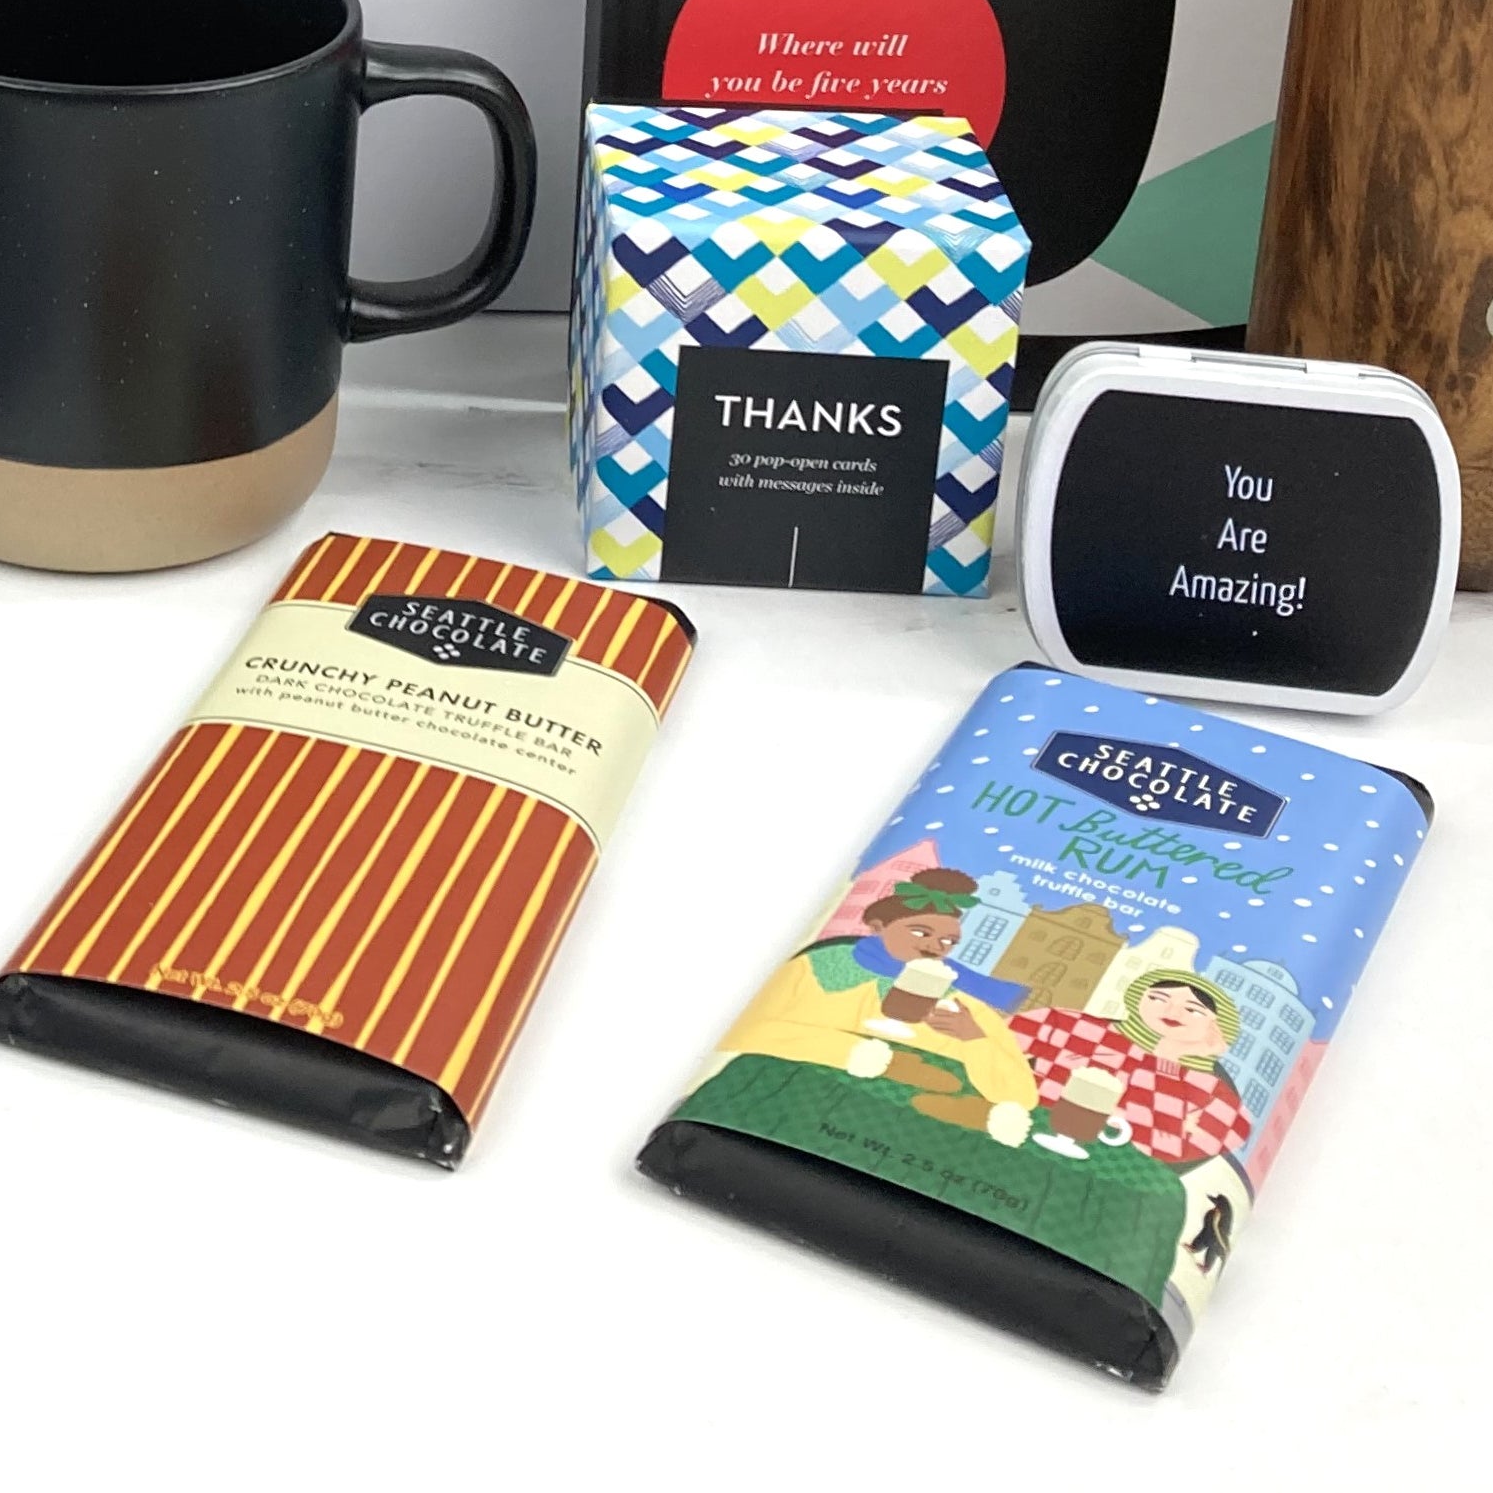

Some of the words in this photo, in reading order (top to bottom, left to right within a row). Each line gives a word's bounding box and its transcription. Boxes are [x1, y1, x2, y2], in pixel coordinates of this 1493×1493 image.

[758, 32, 843, 56] Where
[853, 34, 909, 57] will
[704, 76, 762, 99] you
[771, 70, 803, 93] be
[804, 70, 861, 100] five
[864, 78, 948, 100] years
[714, 395, 902, 437] THANKS
[718, 474, 755, 489] with
[758, 479, 833, 495] messages
[836, 480, 885, 496] inside
[728, 453, 751, 467] 30
[753, 455, 829, 472] pop-open
[832, 458, 878, 472] cards
[1224, 464, 1274, 502] You
[1216, 517, 1268, 554] Are
[1168, 564, 1307, 617] Amazing!
[369, 611, 548, 664] CHOCOLATE
[402, 601, 532, 643] SEATTLE
[234, 686, 274, 699] with
[278, 690, 344, 710] peanut
[351, 701, 410, 725] butter
[416, 717, 509, 750] chocolate
[514, 743, 577, 776] center
[244, 656, 380, 687] CRUNCHY
[385, 678, 498, 715] PEANUT
[504, 708, 603, 757] BUTTER
[255, 674, 308, 689] DARK
[314, 682, 435, 716] CHOCOLATE
[444, 710, 528, 742] TRUFFLE
[533, 735, 574, 759] BAR
[1057, 752, 1257, 824] CHOCOLATE
[1094, 744, 1238, 797] SEATTLE
[971, 780, 1076, 824] HOT
[1058, 809, 1294, 895] Buttered
[1059, 836, 1169, 889] RUM
[1009, 853, 1057, 875] milk
[1063, 869, 1182, 915] chocolate
[1032, 874, 1097, 903] truffle
[1103, 899, 1144, 918] bar
